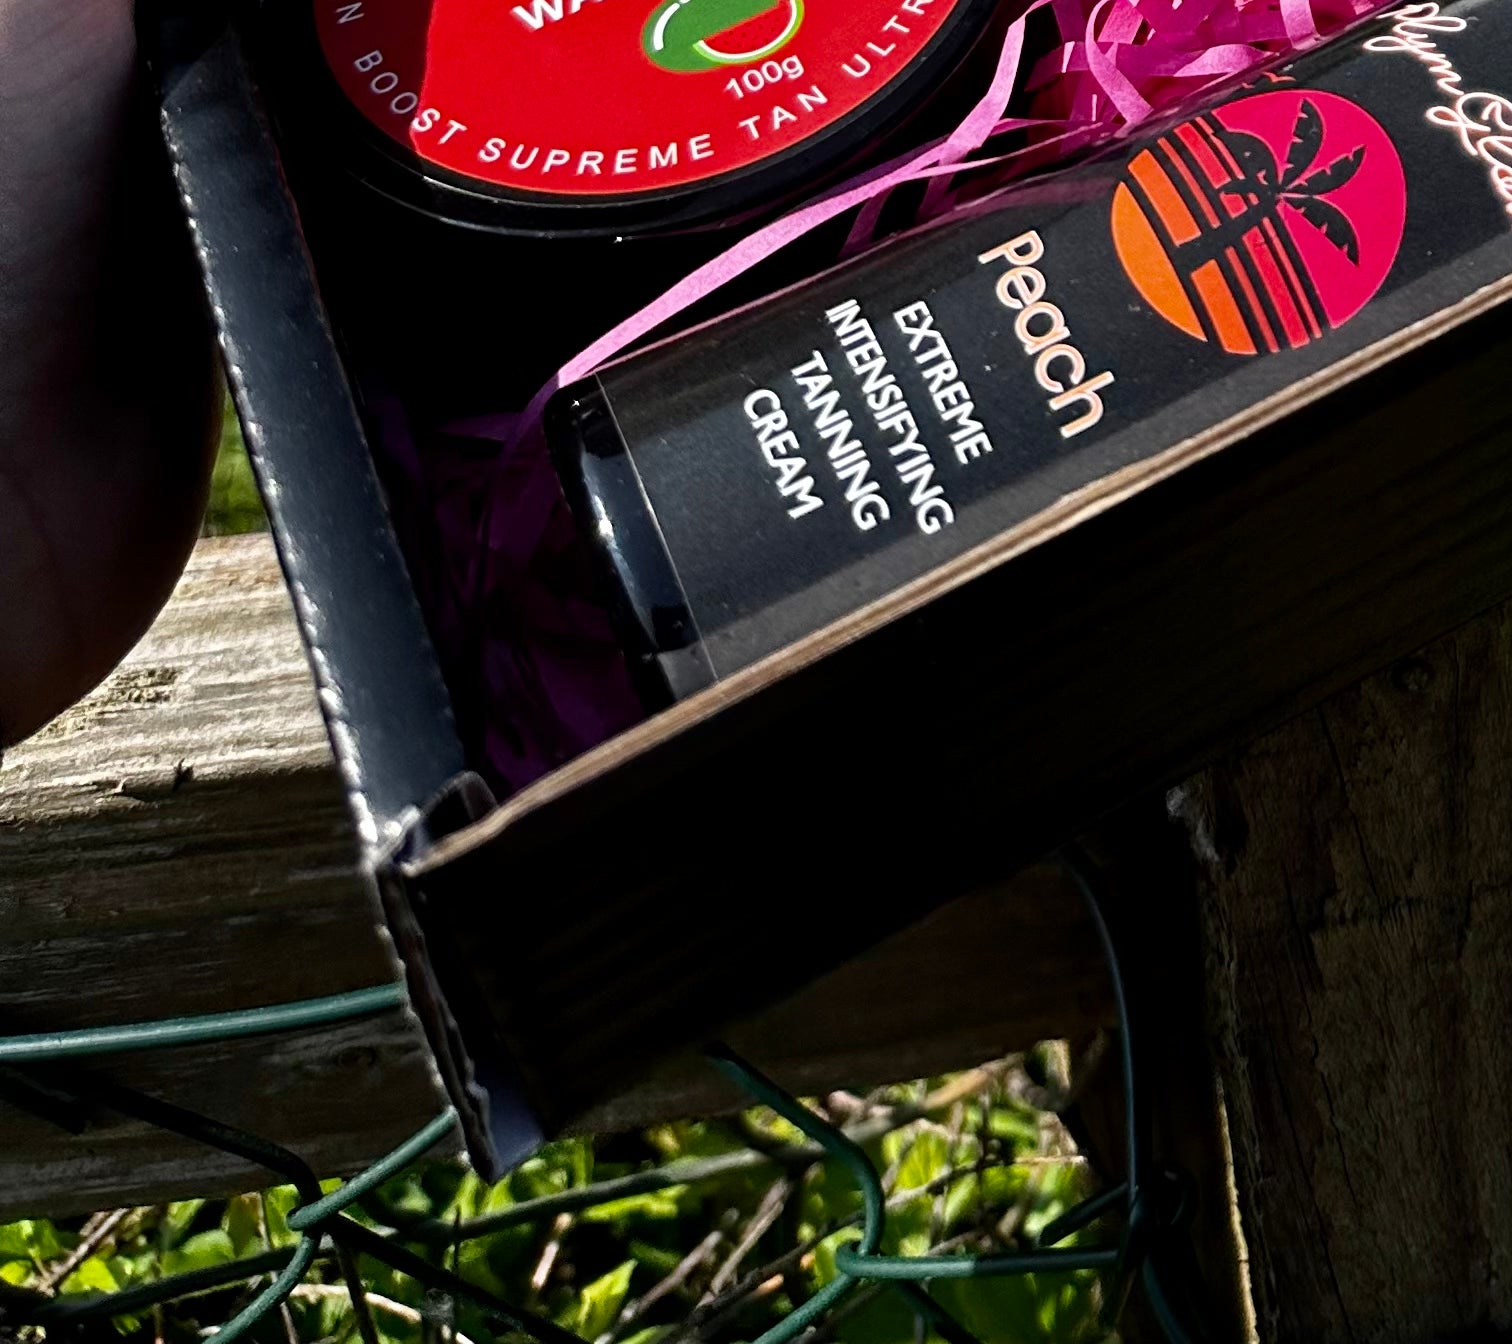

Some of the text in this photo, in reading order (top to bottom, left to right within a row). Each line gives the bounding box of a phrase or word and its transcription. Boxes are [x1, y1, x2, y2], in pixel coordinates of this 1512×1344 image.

[353, 49, 467, 146] BOOST
[477, 133, 715, 178] SUPREME
[738, 84, 828, 140] TAN
[723, 55, 805, 100] 100g
[825, 298, 955, 535] INTENSIFYING
[893, 299, 993, 465] EXTREME
[977, 229, 1115, 438] Peach
[743, 387, 825, 520] CREAM
[790, 349, 891, 532] TANNING
